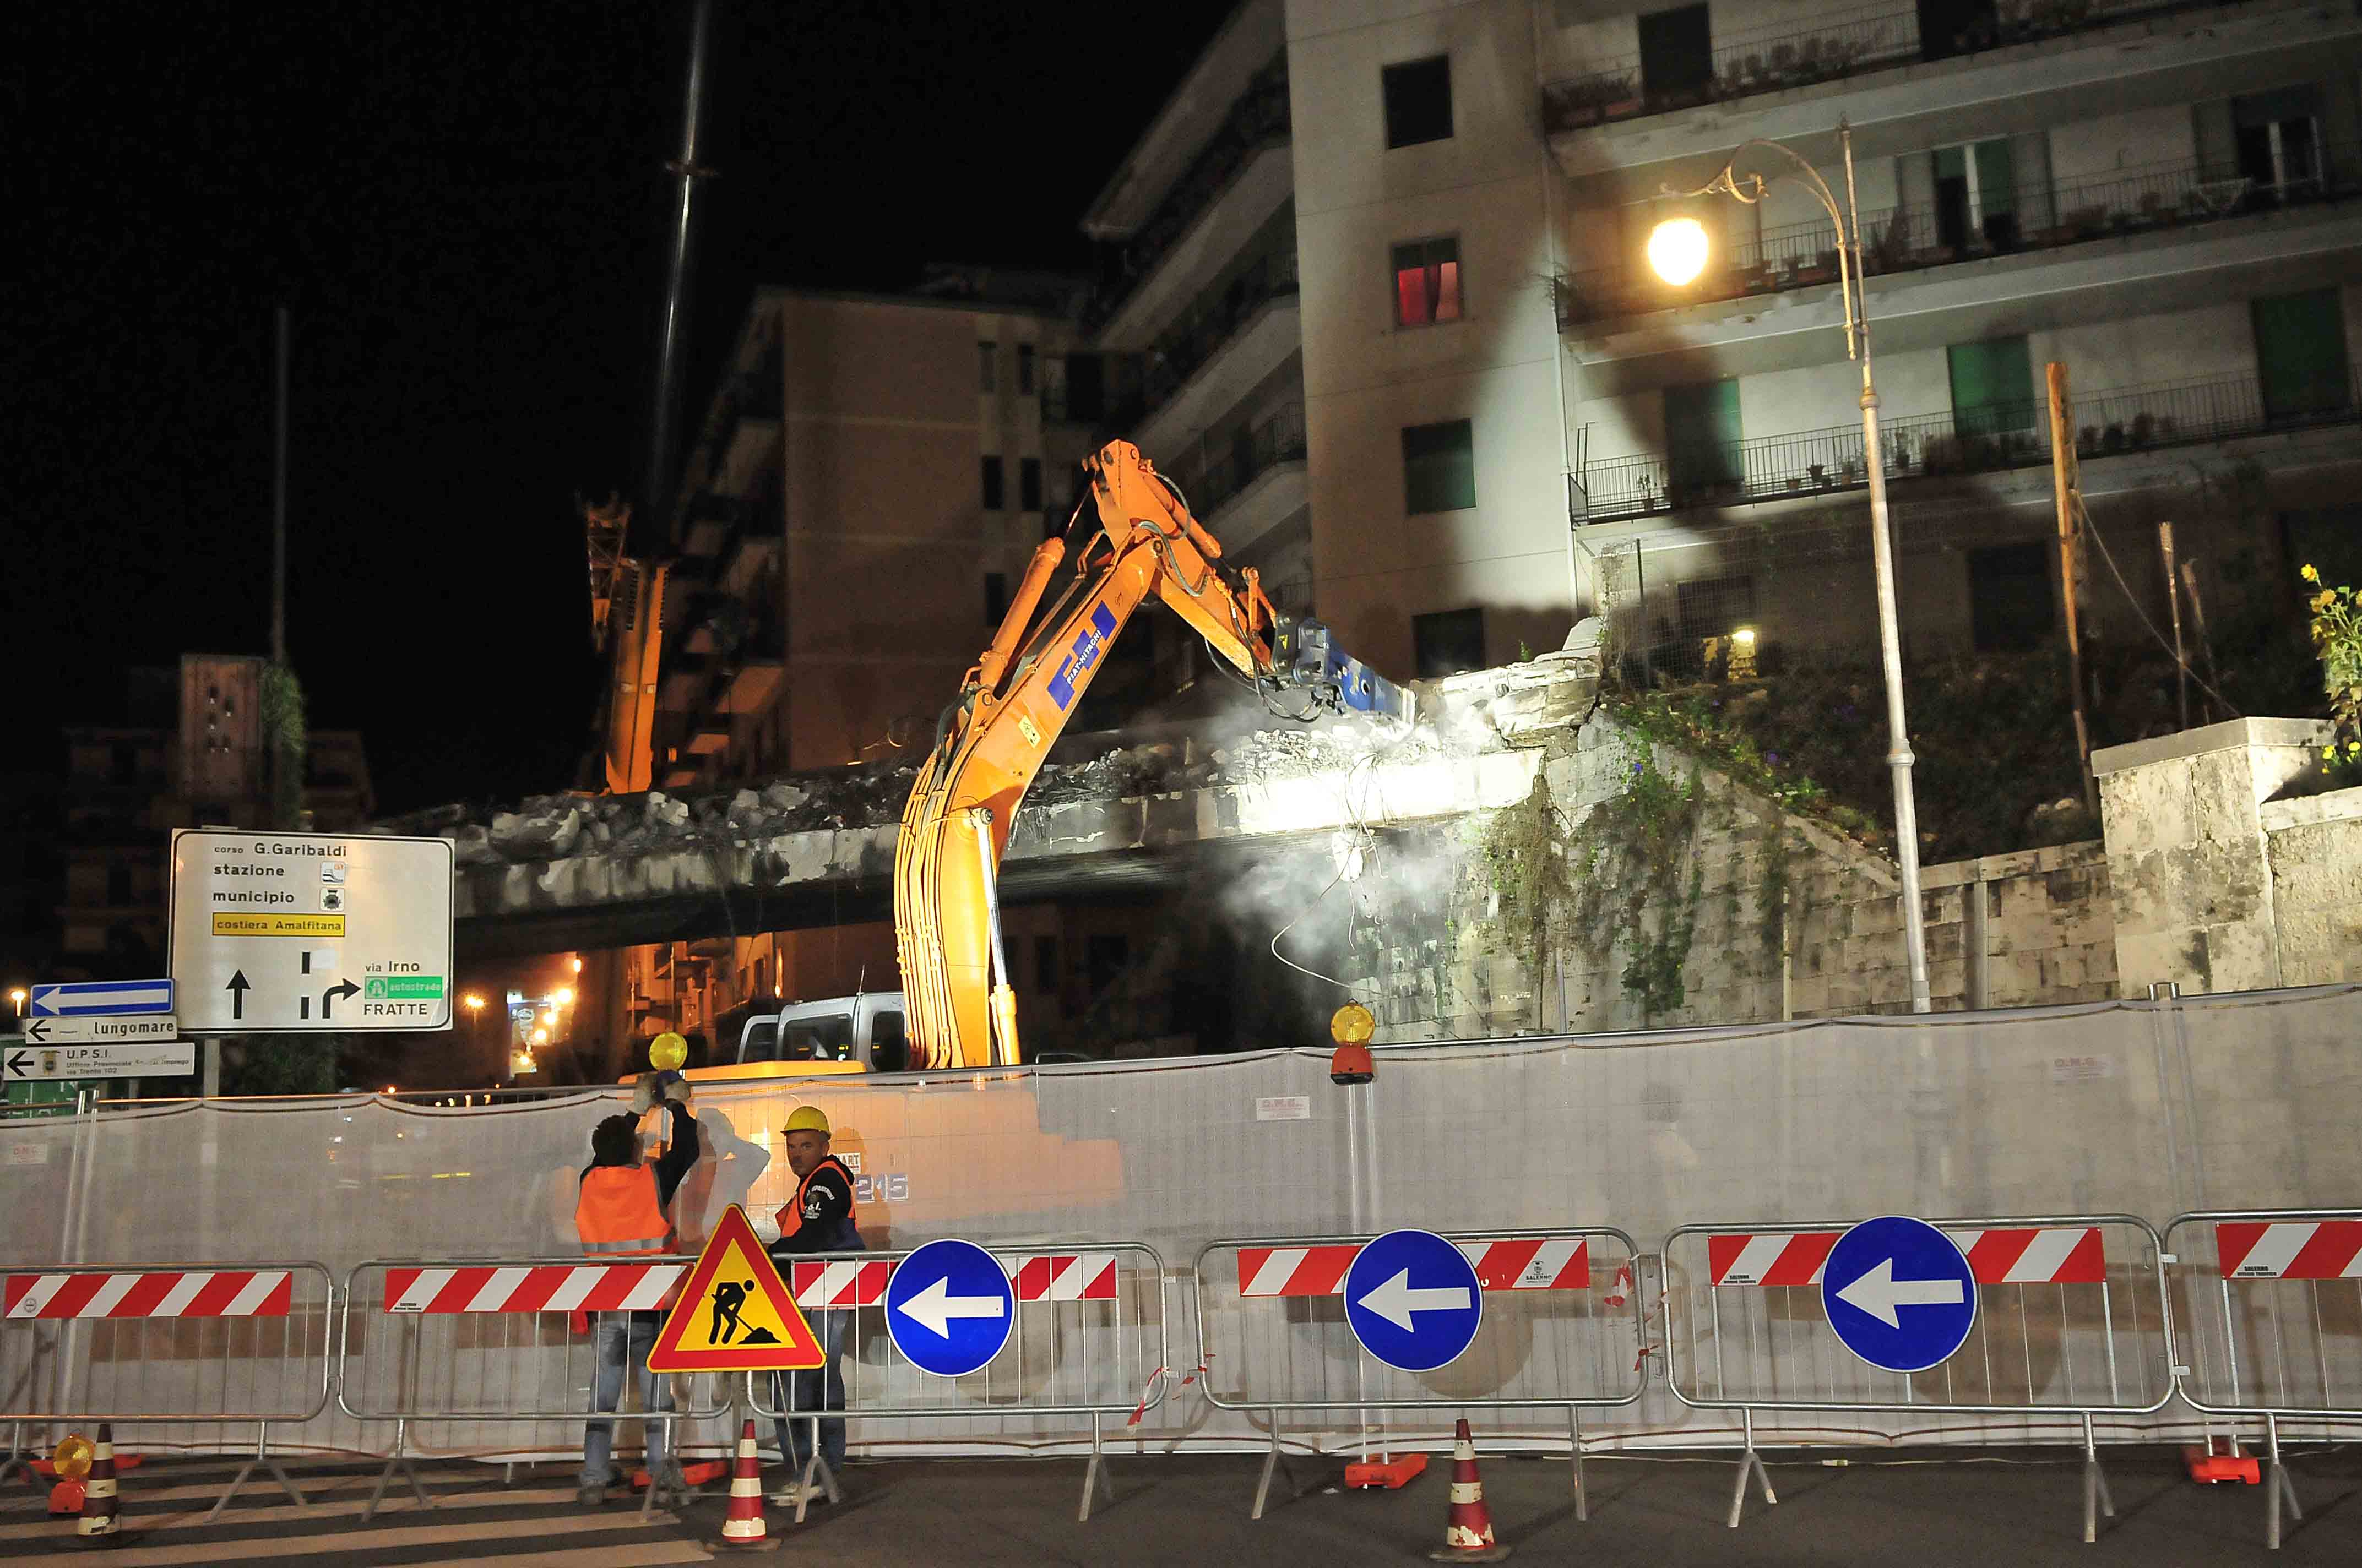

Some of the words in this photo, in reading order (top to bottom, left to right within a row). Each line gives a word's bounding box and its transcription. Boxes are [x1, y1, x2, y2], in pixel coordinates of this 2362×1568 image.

[1066, 629, 1101, 684] FIAT-HITACHI
[254, 842, 346, 856] G.Garibaldi
[214, 863, 285, 876] stazione
[213, 890, 294, 904] municipio
[217, 921, 268, 929] costiera
[275, 921, 341, 930] Amalfitana
[365, 963, 382, 972] via
[389, 961, 420, 972] Irno
[363, 1004, 427, 1015] FRATTE
[94, 1021, 174, 1036] lungomare
[67, 1049, 111, 1059] U.P.S.I.
[837, 1154, 859, 1165] ART
